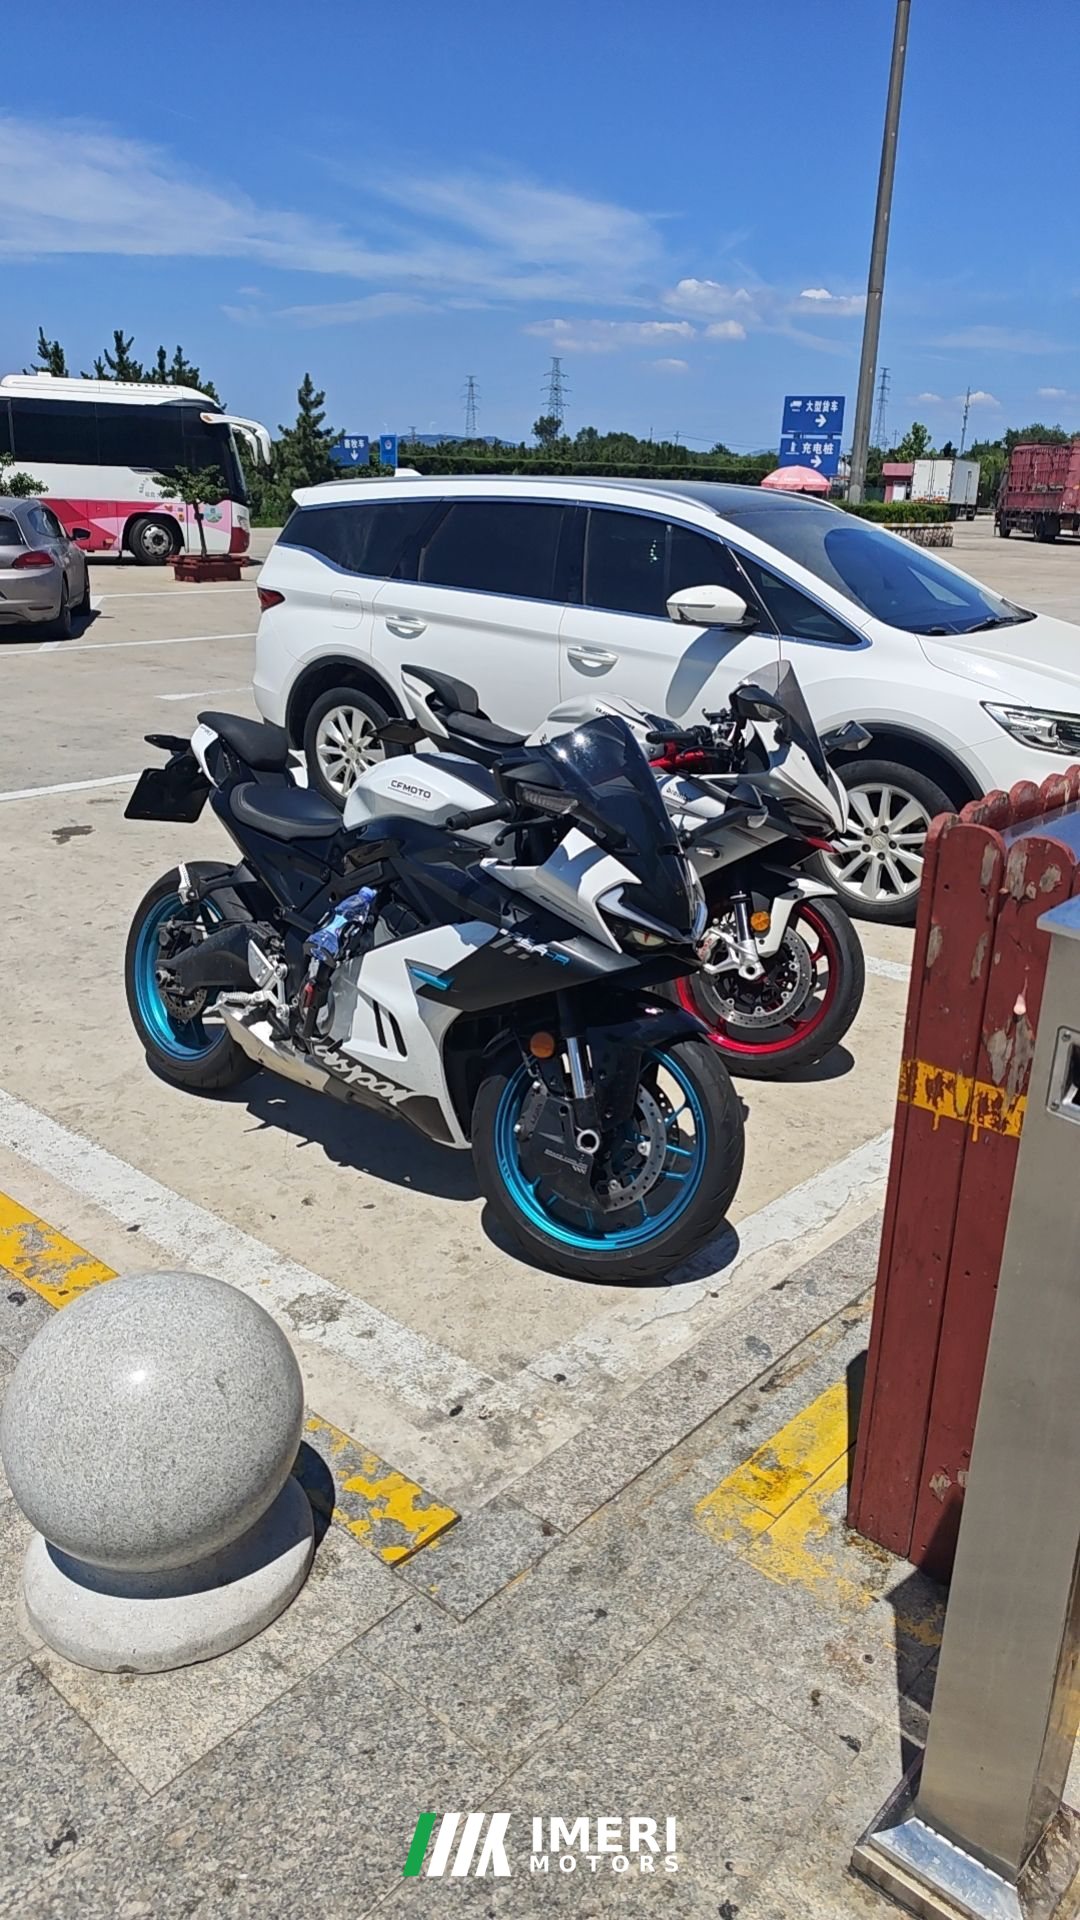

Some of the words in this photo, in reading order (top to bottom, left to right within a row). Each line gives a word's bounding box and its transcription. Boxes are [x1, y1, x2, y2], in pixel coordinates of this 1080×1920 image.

[805, 400, 839, 413] 大型货车
[801, 442, 834, 455] 充电桩
[390, 779, 432, 799] CFMOTO
